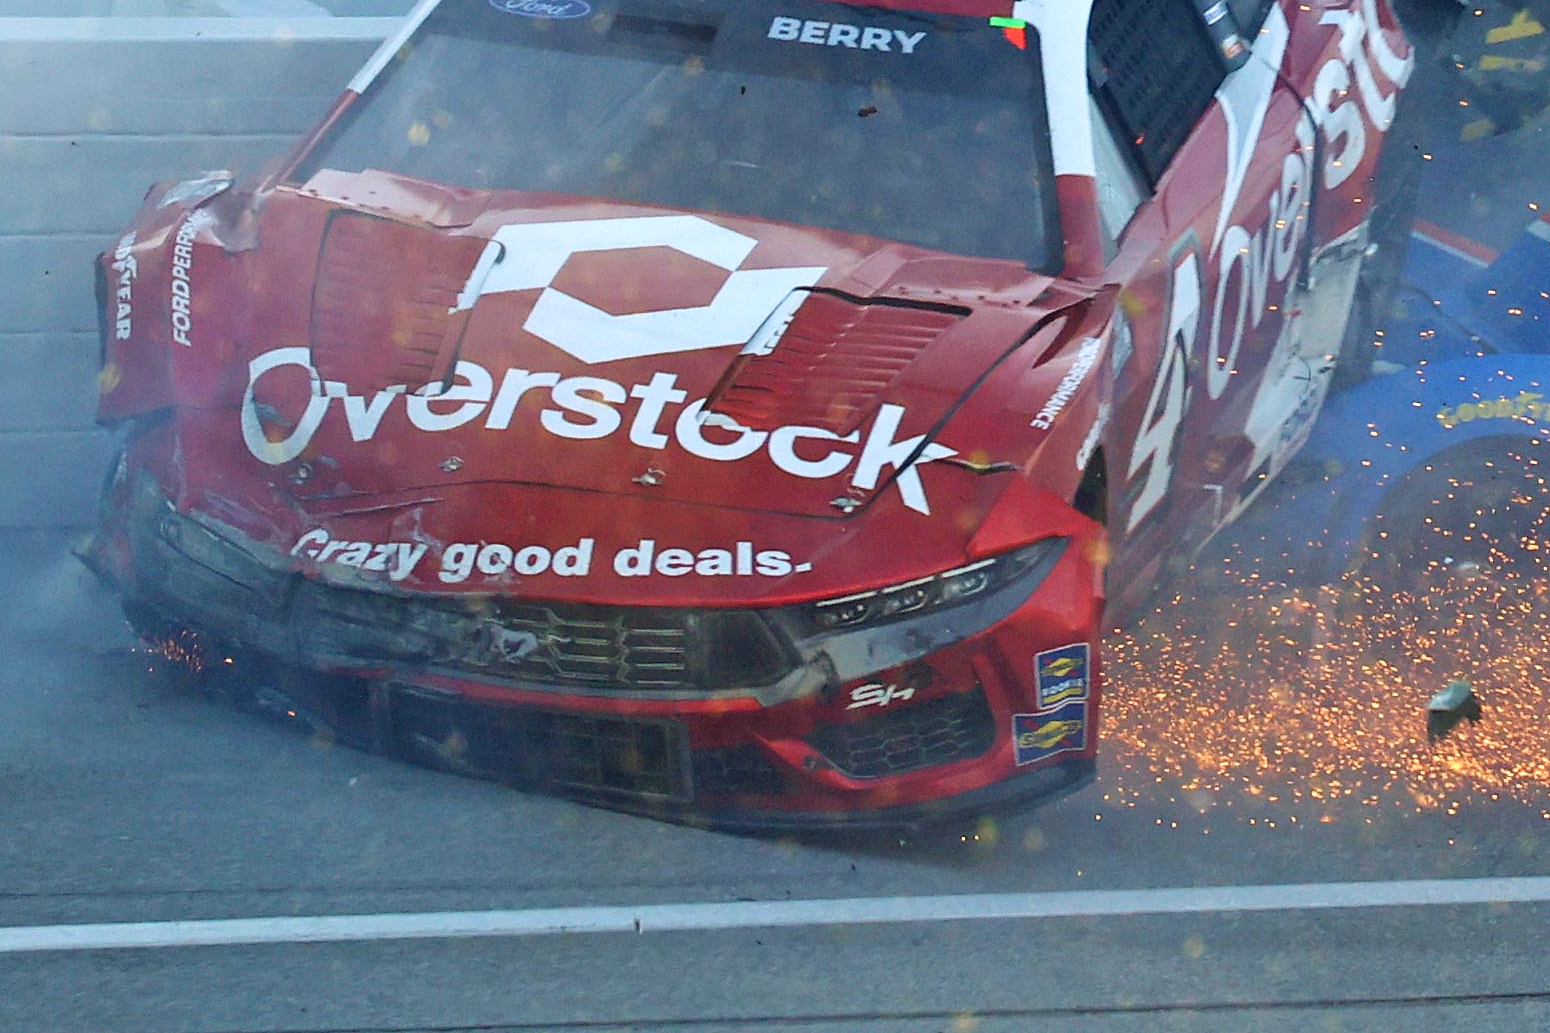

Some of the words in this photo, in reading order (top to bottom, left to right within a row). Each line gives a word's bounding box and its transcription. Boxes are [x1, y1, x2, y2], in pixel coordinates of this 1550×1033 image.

[767, 16, 926, 54] BERRY
[241, 347, 958, 515] Overstock
[292, 528, 426, 582] Crazy
[440, 538, 594, 583] good
